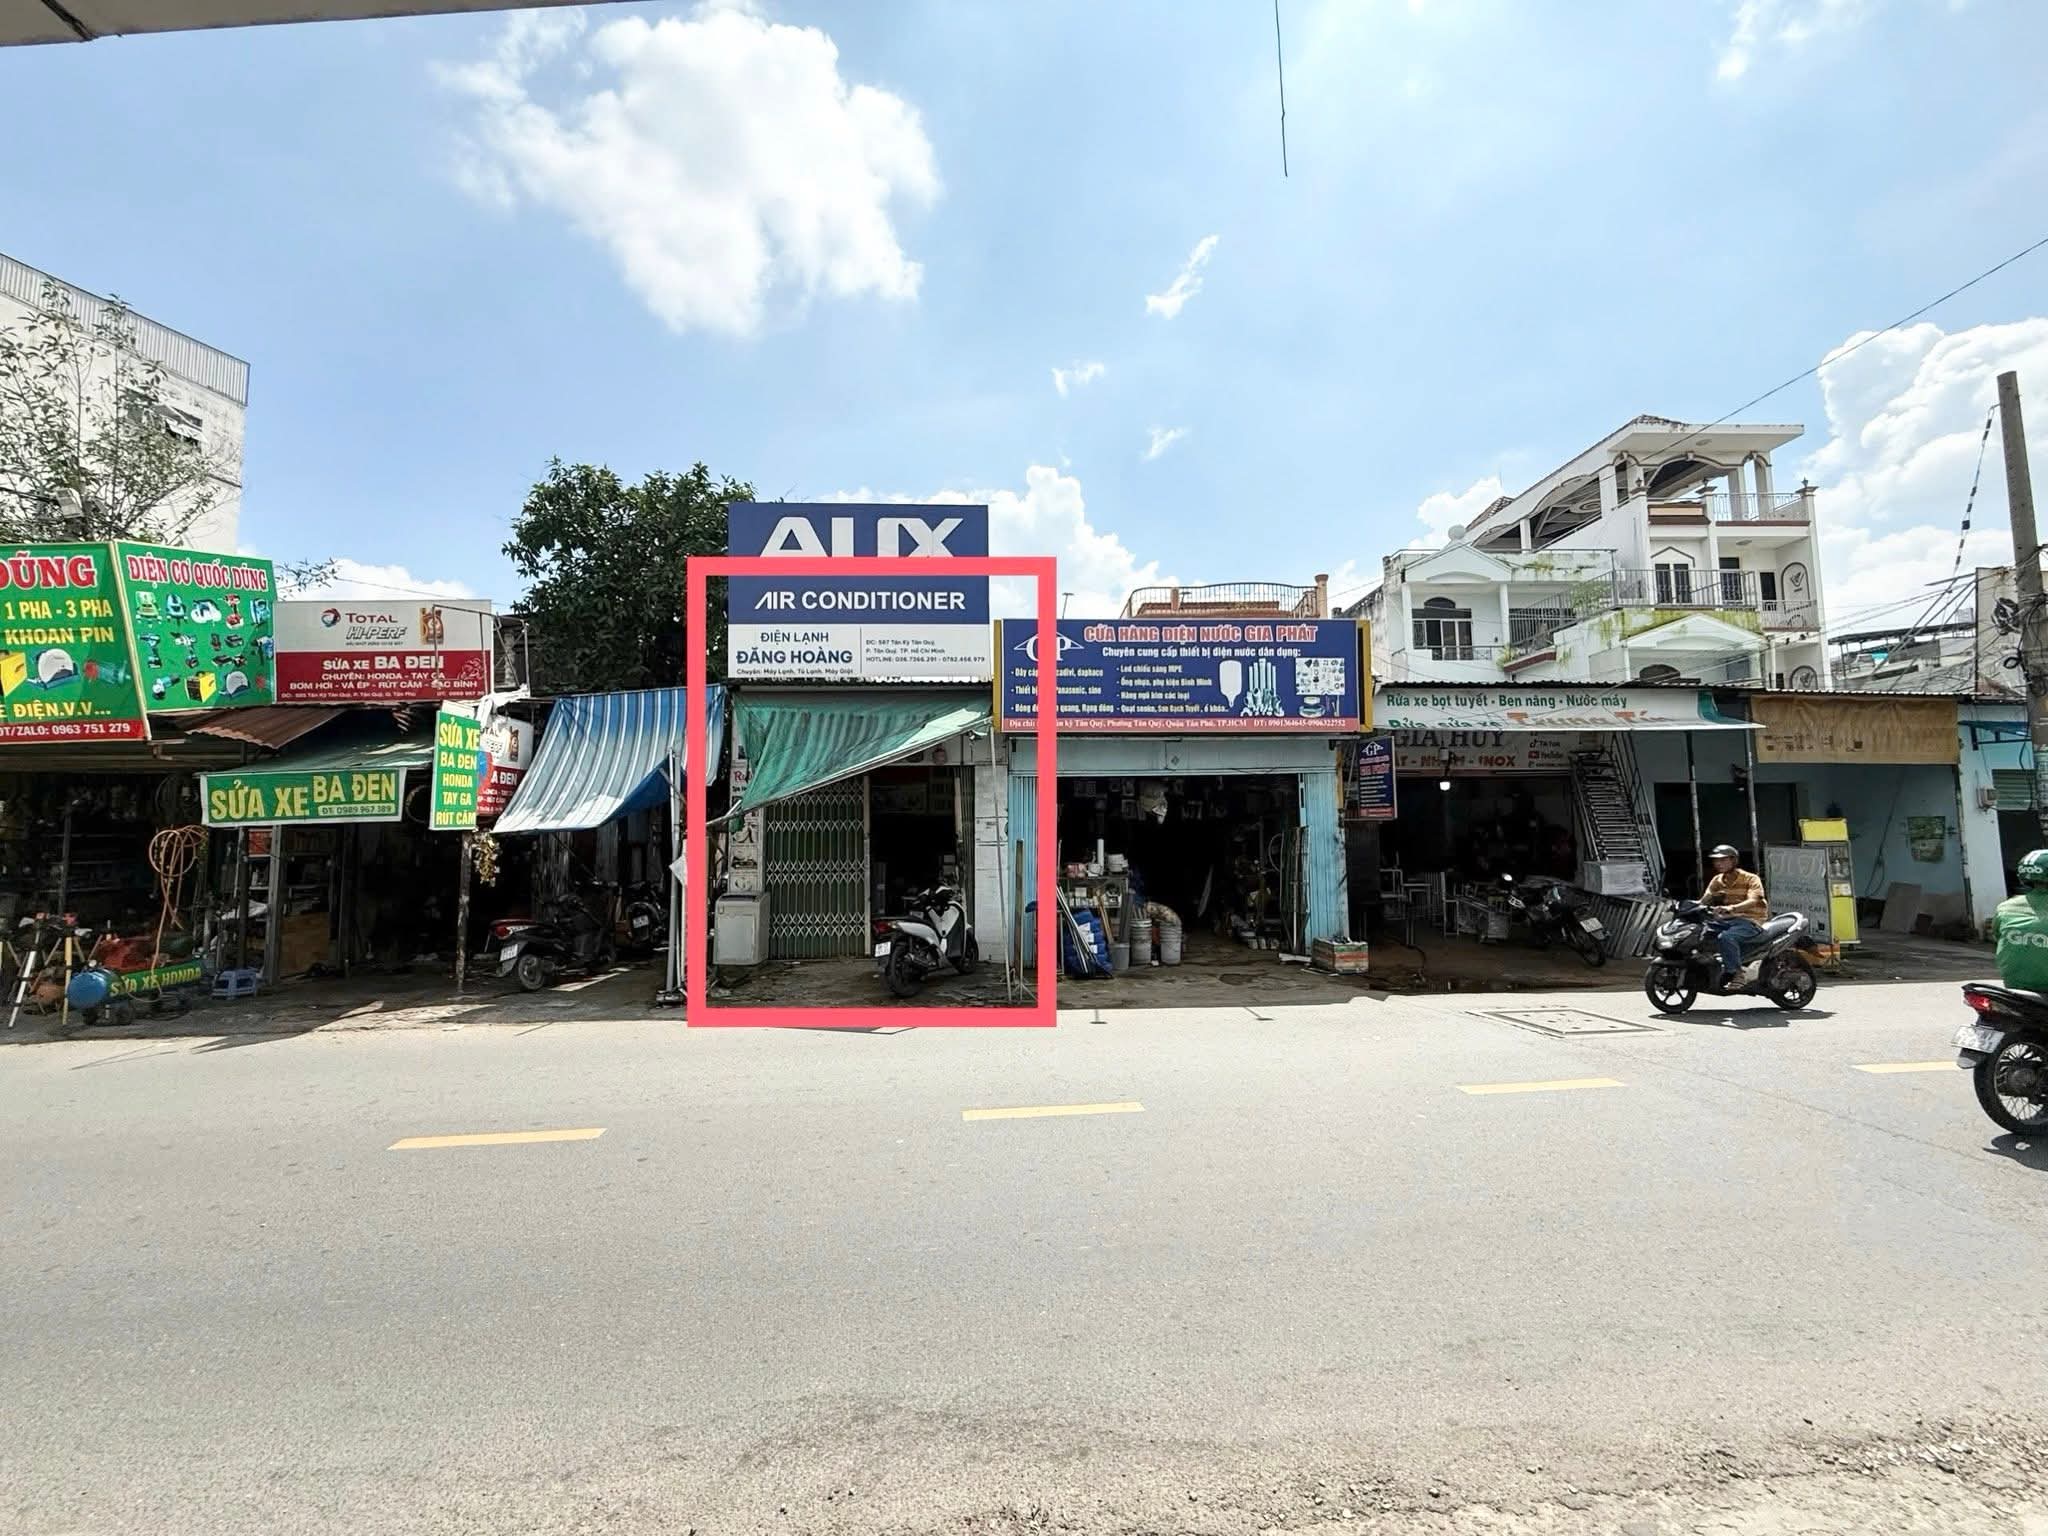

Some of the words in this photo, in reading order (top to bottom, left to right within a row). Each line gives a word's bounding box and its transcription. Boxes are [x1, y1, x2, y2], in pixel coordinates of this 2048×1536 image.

[127, 551, 170, 589] ĐIỆN
[170, 557, 192, 586] CƠ
[193, 558, 231, 589] QUỐC
[754, 591, 796, 610] AIR
[801, 591, 966, 610] CONDITIONER
[4, 602, 16, 620] 1
[19, 600, 53, 619] PHA
[66, 600, 77, 618] 3
[80, 600, 114, 617] PHA
[345, 612, 399, 624] TOTAL
[4, 628, 75, 645] KHOAN
[80, 626, 115, 642] PIN
[760, 629, 791, 646] ĐIỆN
[793, 632, 830, 646] LẠNH
[1083, 623, 1116, 643] CỬA
[1117, 624, 1160, 642] HÀNG
[1161, 624, 1197, 645] ĐIỆN
[1199, 624, 1242, 643] NƯỚC
[1244, 624, 1274, 643] GIA
[1275, 623, 1319, 643] PHÁT
[736, 646, 787, 664] ĐĂNG
[790, 646, 853, 664] HOÀNG
[1102, 646, 1135, 657] Chuyên
[1137, 649, 1159, 657] cung
[1161, 646, 1178, 657] cấp
[1180, 646, 1200, 656] thiết
[1201, 647, 1211, 658] bị
[1212, 647, 1232, 658] điện
[1234, 648, 1256, 656] nước
[1258, 647, 1275, 656] dân
[1276, 647, 1301, 658] dụng:
[323, 658, 350, 669] SỬA
[353, 660, 370, 669] XE
[374, 656, 401, 669] BA
[405, 656, 444, 669] ĐEN
[1152, 665, 1167, 673] sáng
[367, 672, 403, 680] HONDA
[411, 672, 428, 680] TAY
[1015, 668, 1027, 677] Dây
[379, 680, 398, 689] RÚT
[454, 680, 478, 688] BÌNH
[1386, 693, 1410, 706] Rửa
[1414, 697, 1428, 706] xe
[1432, 695, 1451, 710] bọt
[1455, 694, 1488, 709] tuyết
[1499, 695, 1521, 706] Ben
[1525, 694, 1556, 708] nâng
[1564, 694, 1597, 706] Nước
[1601, 694, 1627, 708] máy
[0, 726, 50, 736] T/ZALO:
[52, 725, 80, 734] 0963
[84, 724, 104, 733] 751
[109, 723, 130, 732] 279
[1009, 719, 1020, 727] Địa
[439, 716, 463, 748] SỬA
[465, 728, 480, 750] XE
[1448, 730, 1505, 747] HUY
[440, 752, 455, 768] BA
[457, 755, 478, 770] ĐEN
[442, 773, 473, 788] HONDA
[211, 779, 264, 820] SỬA
[274, 787, 310, 817] XE
[313, 775, 345, 803] BA
[352, 773, 396, 800] ĐEN
[442, 791, 458, 805] TAY
[460, 793, 472, 806] GA
[435, 808, 454, 825] RÚT
[2018, 865, 2043, 874] Grab
[142, 974, 158, 990] XE
[161, 967, 202, 986] HONDA
